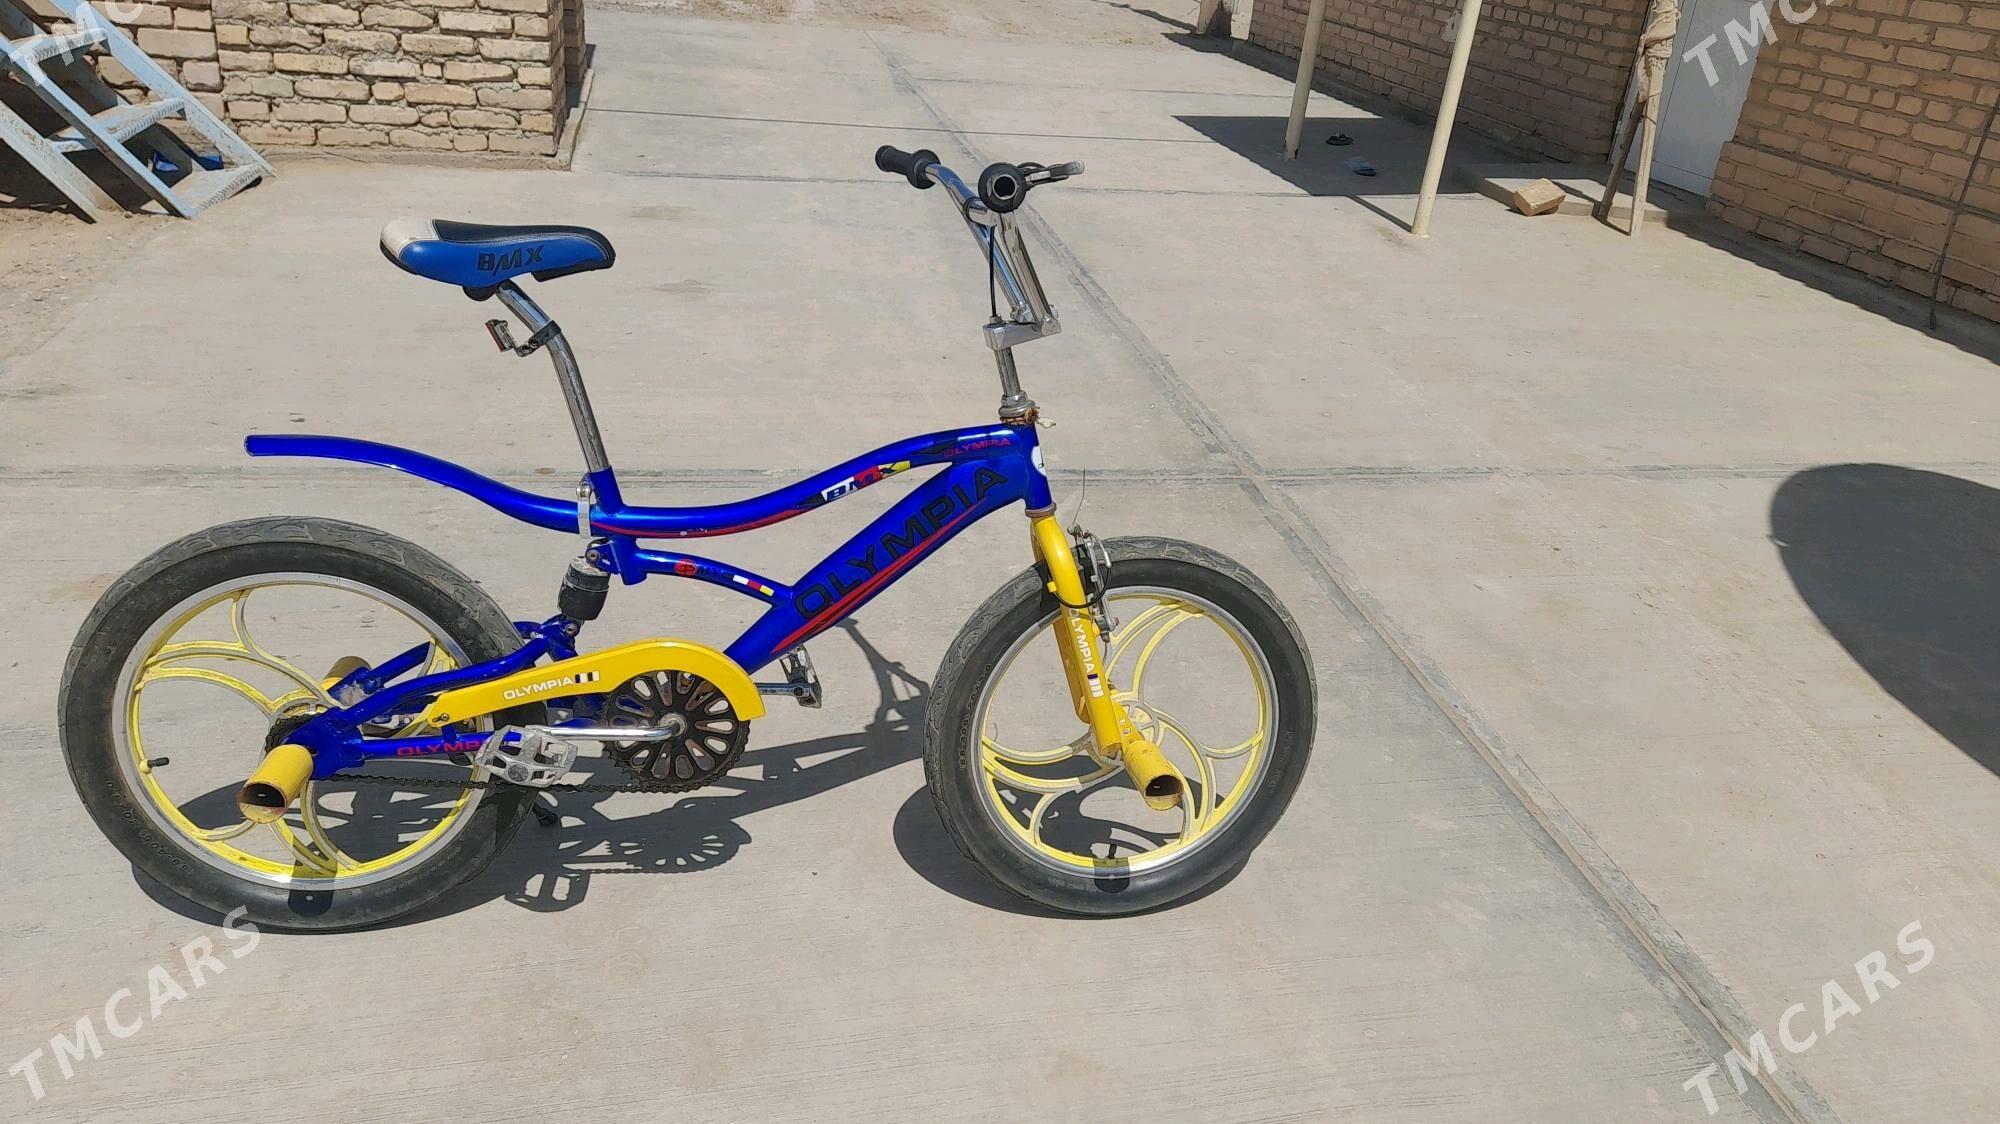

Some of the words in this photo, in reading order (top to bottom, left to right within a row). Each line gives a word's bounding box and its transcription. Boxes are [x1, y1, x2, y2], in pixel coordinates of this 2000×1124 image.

[476, 244, 546, 276] BMX
[943, 438, 1011, 457] OLYMPIA
[826, 462, 898, 501] BMX
[793, 465, 1009, 619] OLYMPIA
[1068, 608, 1096, 673] OLYMPIA
[503, 676, 574, 700] OLYMPIA
[396, 740, 486, 757] OLYMP
